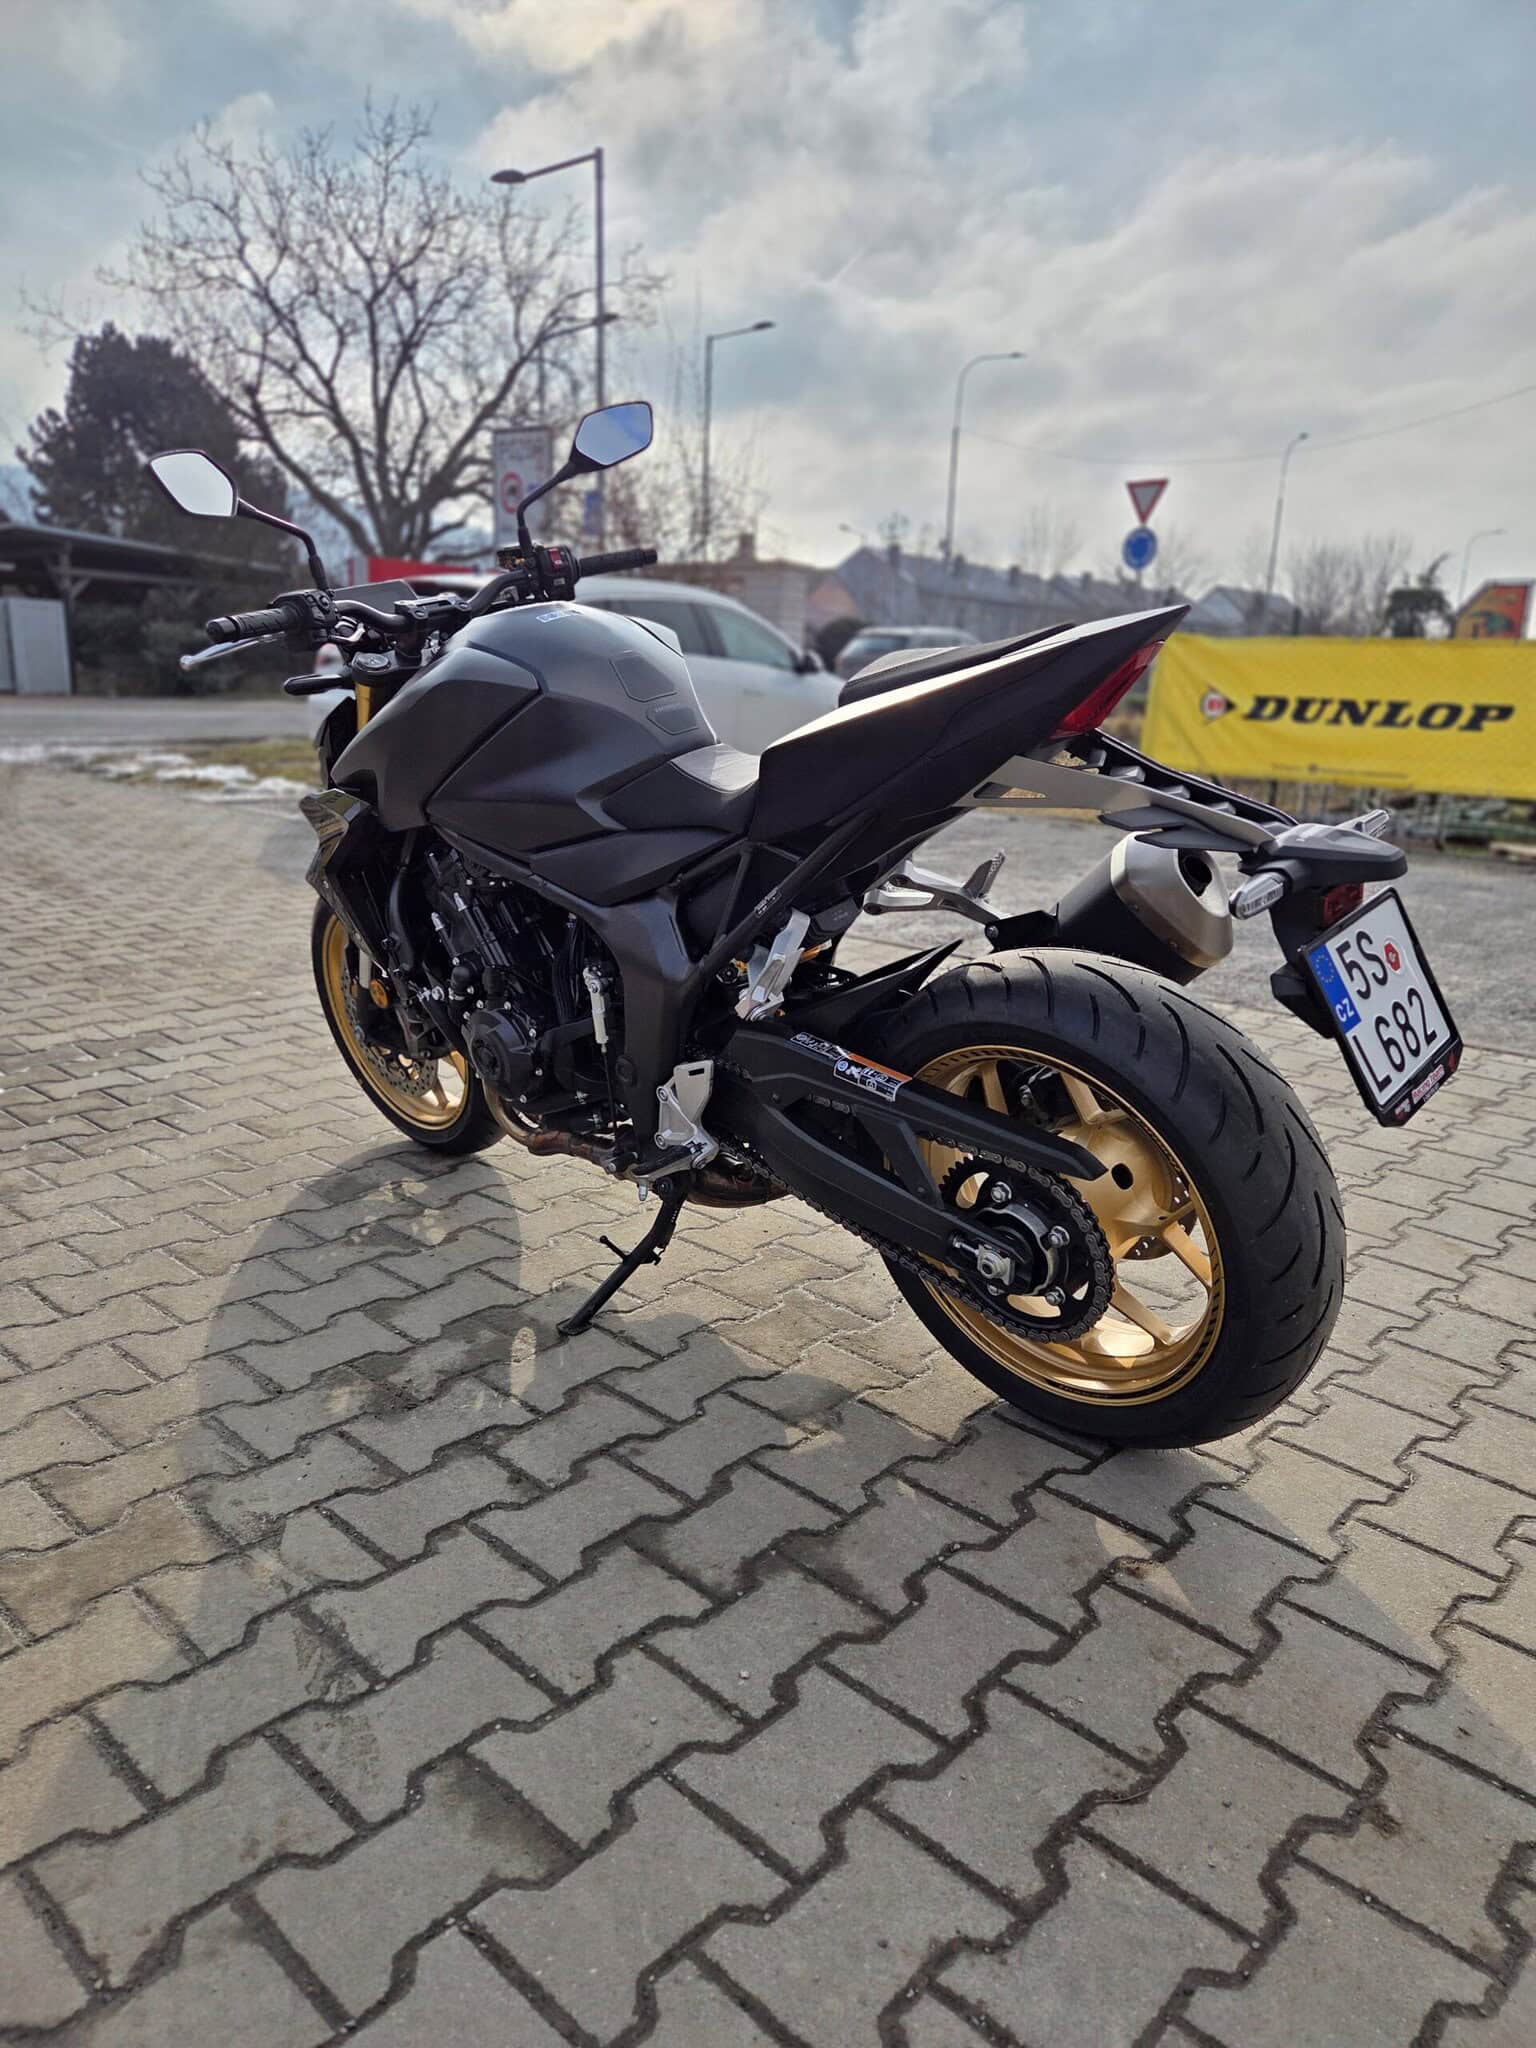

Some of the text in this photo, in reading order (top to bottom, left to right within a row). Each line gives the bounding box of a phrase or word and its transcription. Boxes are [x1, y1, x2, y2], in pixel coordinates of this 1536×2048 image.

[1244, 695, 1514, 731] DUNLOP
[1336, 931, 1388, 1000] 5S
[1335, 998, 1355, 1022] CZ
[1353, 988, 1436, 1092] L682
